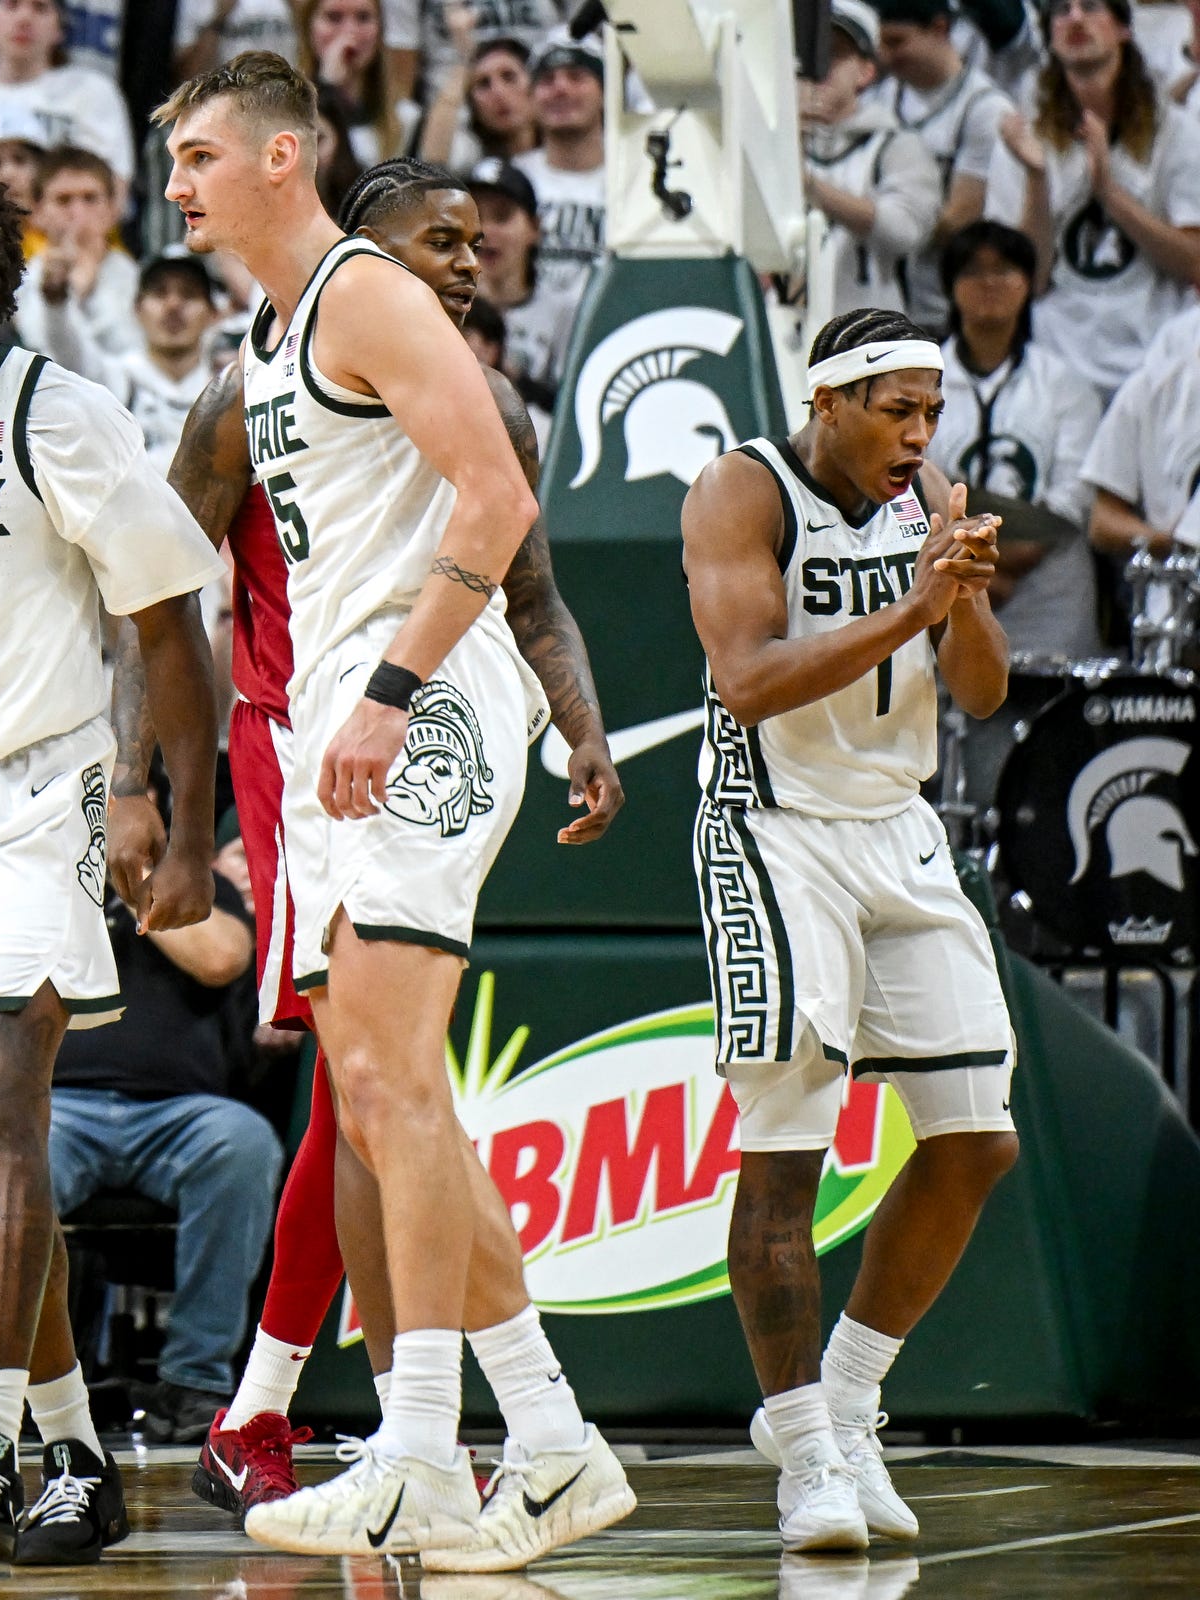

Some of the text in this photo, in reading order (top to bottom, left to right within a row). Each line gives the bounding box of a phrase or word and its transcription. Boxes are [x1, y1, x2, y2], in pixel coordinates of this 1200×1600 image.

[244, 391, 309, 465] TATE
[802, 550, 920, 616] STAT
[1111, 696, 1196, 723] YAMAHA
